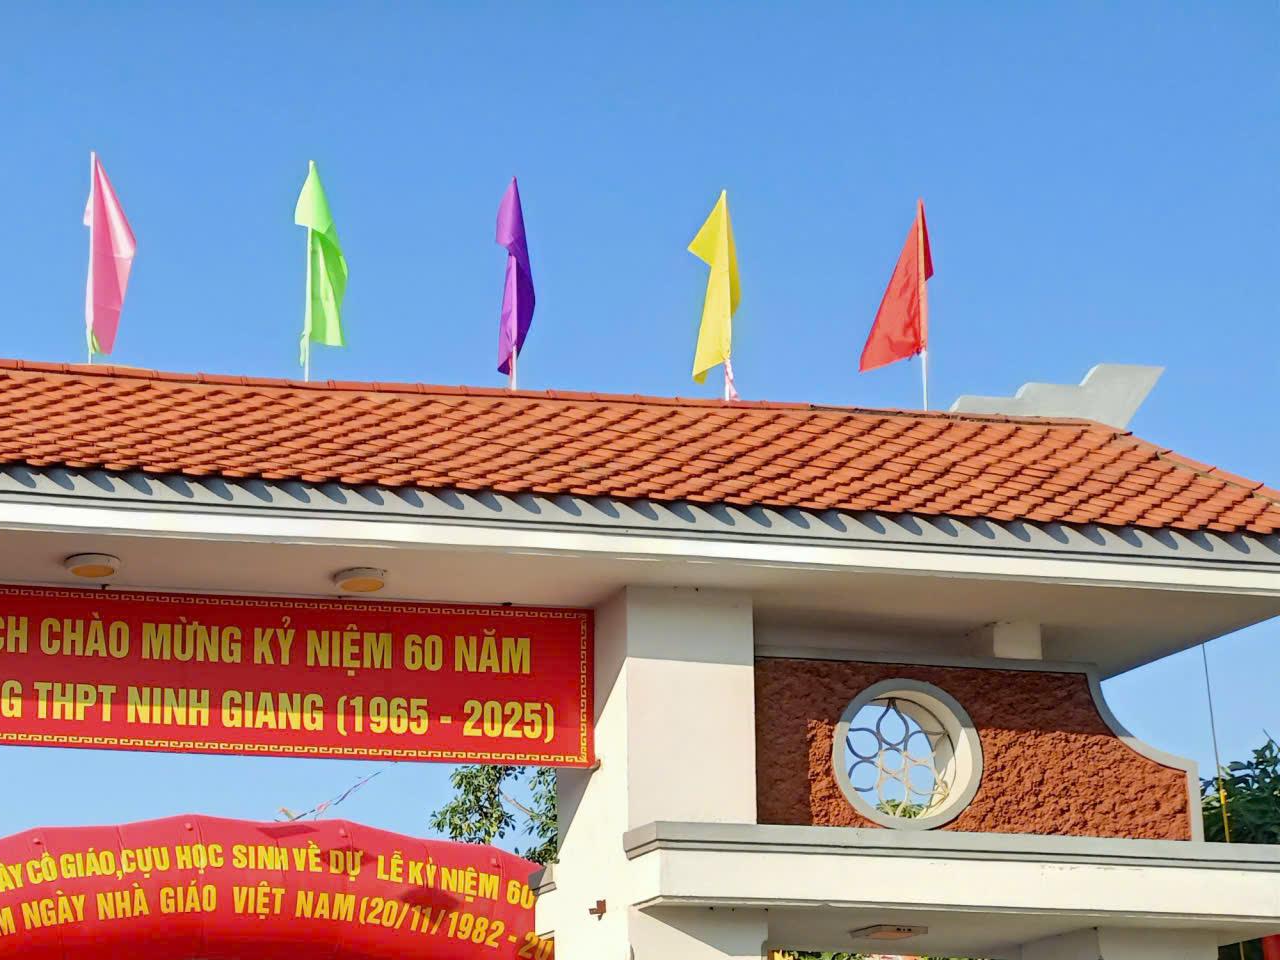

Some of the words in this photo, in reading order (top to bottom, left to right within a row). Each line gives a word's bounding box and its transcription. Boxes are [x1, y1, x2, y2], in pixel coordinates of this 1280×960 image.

[40, 612, 130, 659] CHÀO
[141, 621, 242, 664] MỪNG
[253, 615, 297, 666] KỶ
[307, 624, 393, 677] NIỆM
[404, 635, 444, 672] 60
[454, 628, 531, 674] NĂM
[34, 682, 118, 722] THPT
[127, 687, 210, 727] NINH
[221, 690, 324, 731] GIANG
[336, 696, 429, 737] (1965
[440, 715, 452, 724] -
[462, 700, 556, 744] 2025)
[23, 890, 86, 930] NGÀY
[96, 882, 150, 920] NHÀ
[160, 880, 216, 913] GIÁO
[233, 880, 285, 919] VIỆT
[295, 891, 356, 921] NAM
[26, 852, 57, 884] CÔ
[60, 848, 123, 880] GIÁO,
[121, 846, 170, 878] CỰU
[175, 843, 224, 874] HỌC
[232, 844, 288, 870] SINH
[292, 840, 322, 873] VỀ
[330, 850, 363, 881] DỰ
[377, 850, 404, 883] LỄ
[440, 867, 500, 903] NIỆM
[506, 879, 535, 910] 60
